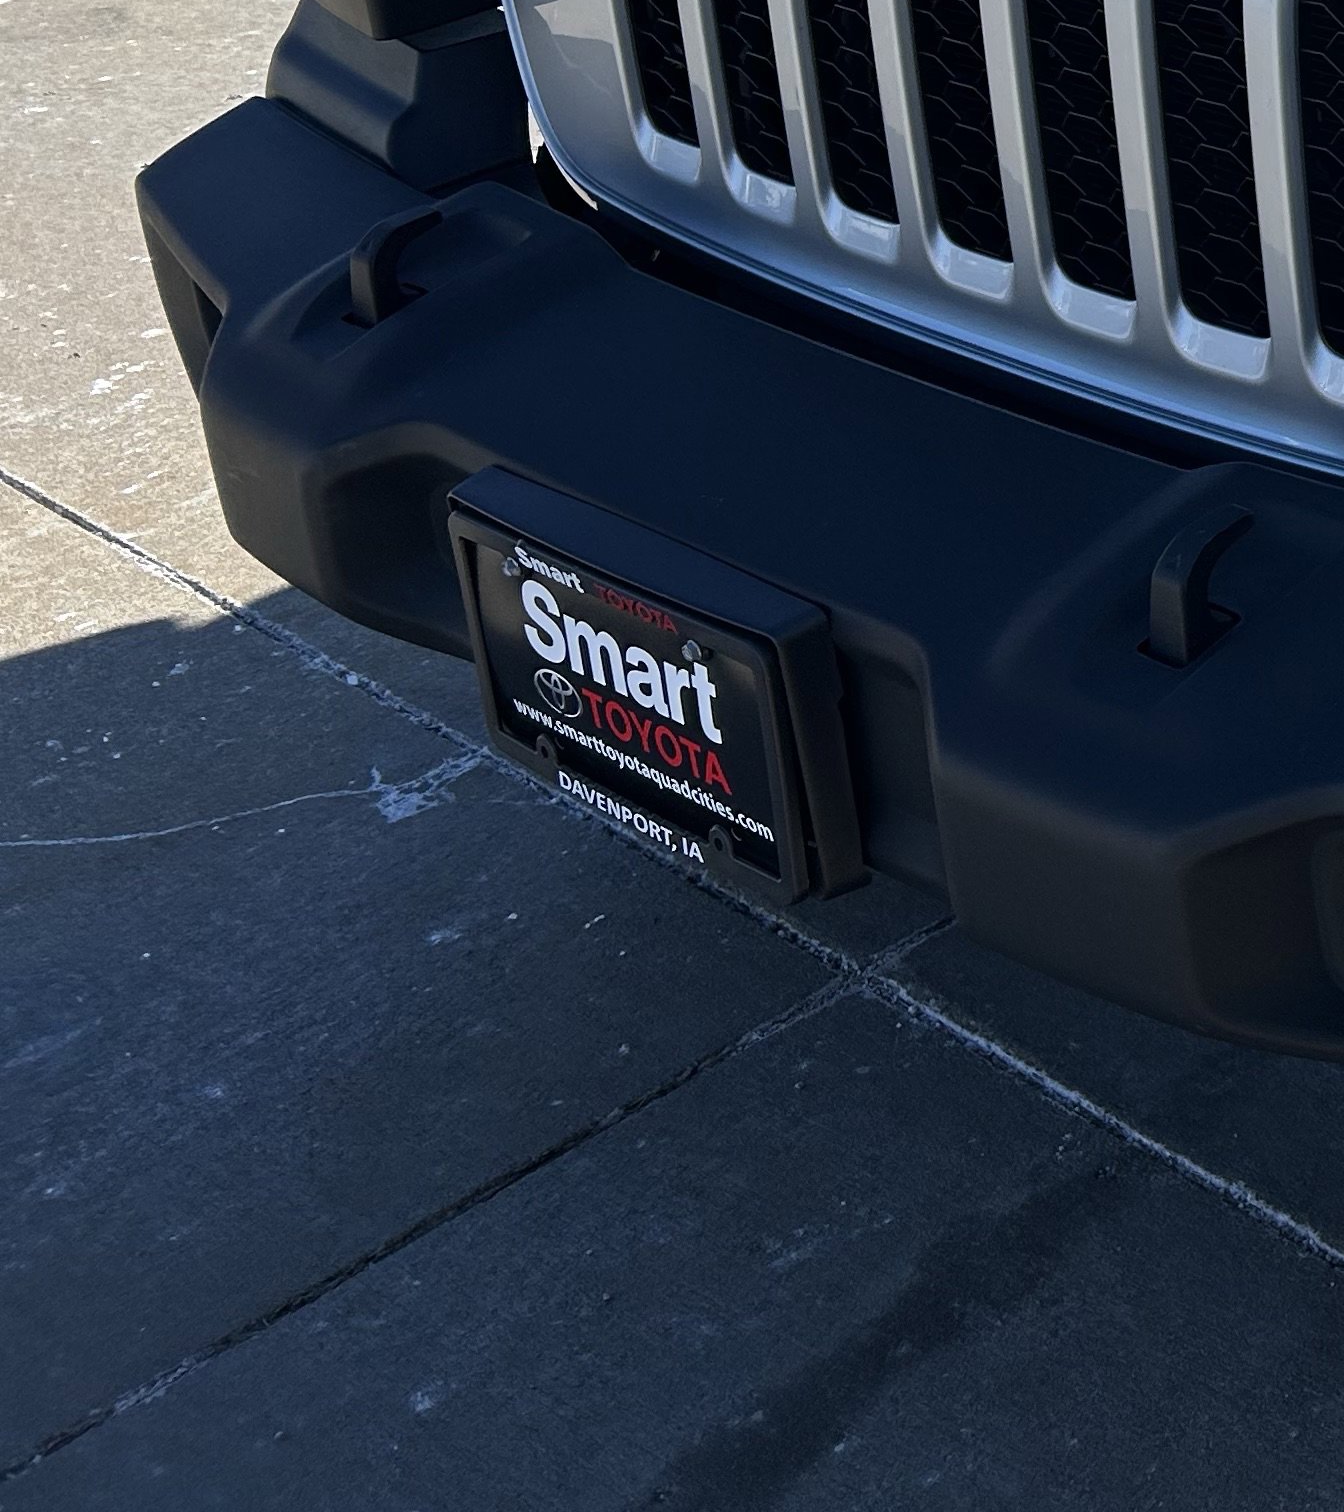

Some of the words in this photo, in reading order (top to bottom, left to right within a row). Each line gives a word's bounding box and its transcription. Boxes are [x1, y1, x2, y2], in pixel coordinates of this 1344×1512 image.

[514, 545, 585, 594] Smart
[594, 583, 679, 635] TOYOTA
[521, 578, 723, 745] Smart
[512, 698, 775, 843] www.smarttoyotaquadcities.com
[581, 687, 732, 796] TOYOTA
[558, 770, 677, 852] DAVENPORT,
[682, 836, 705, 863] IA
